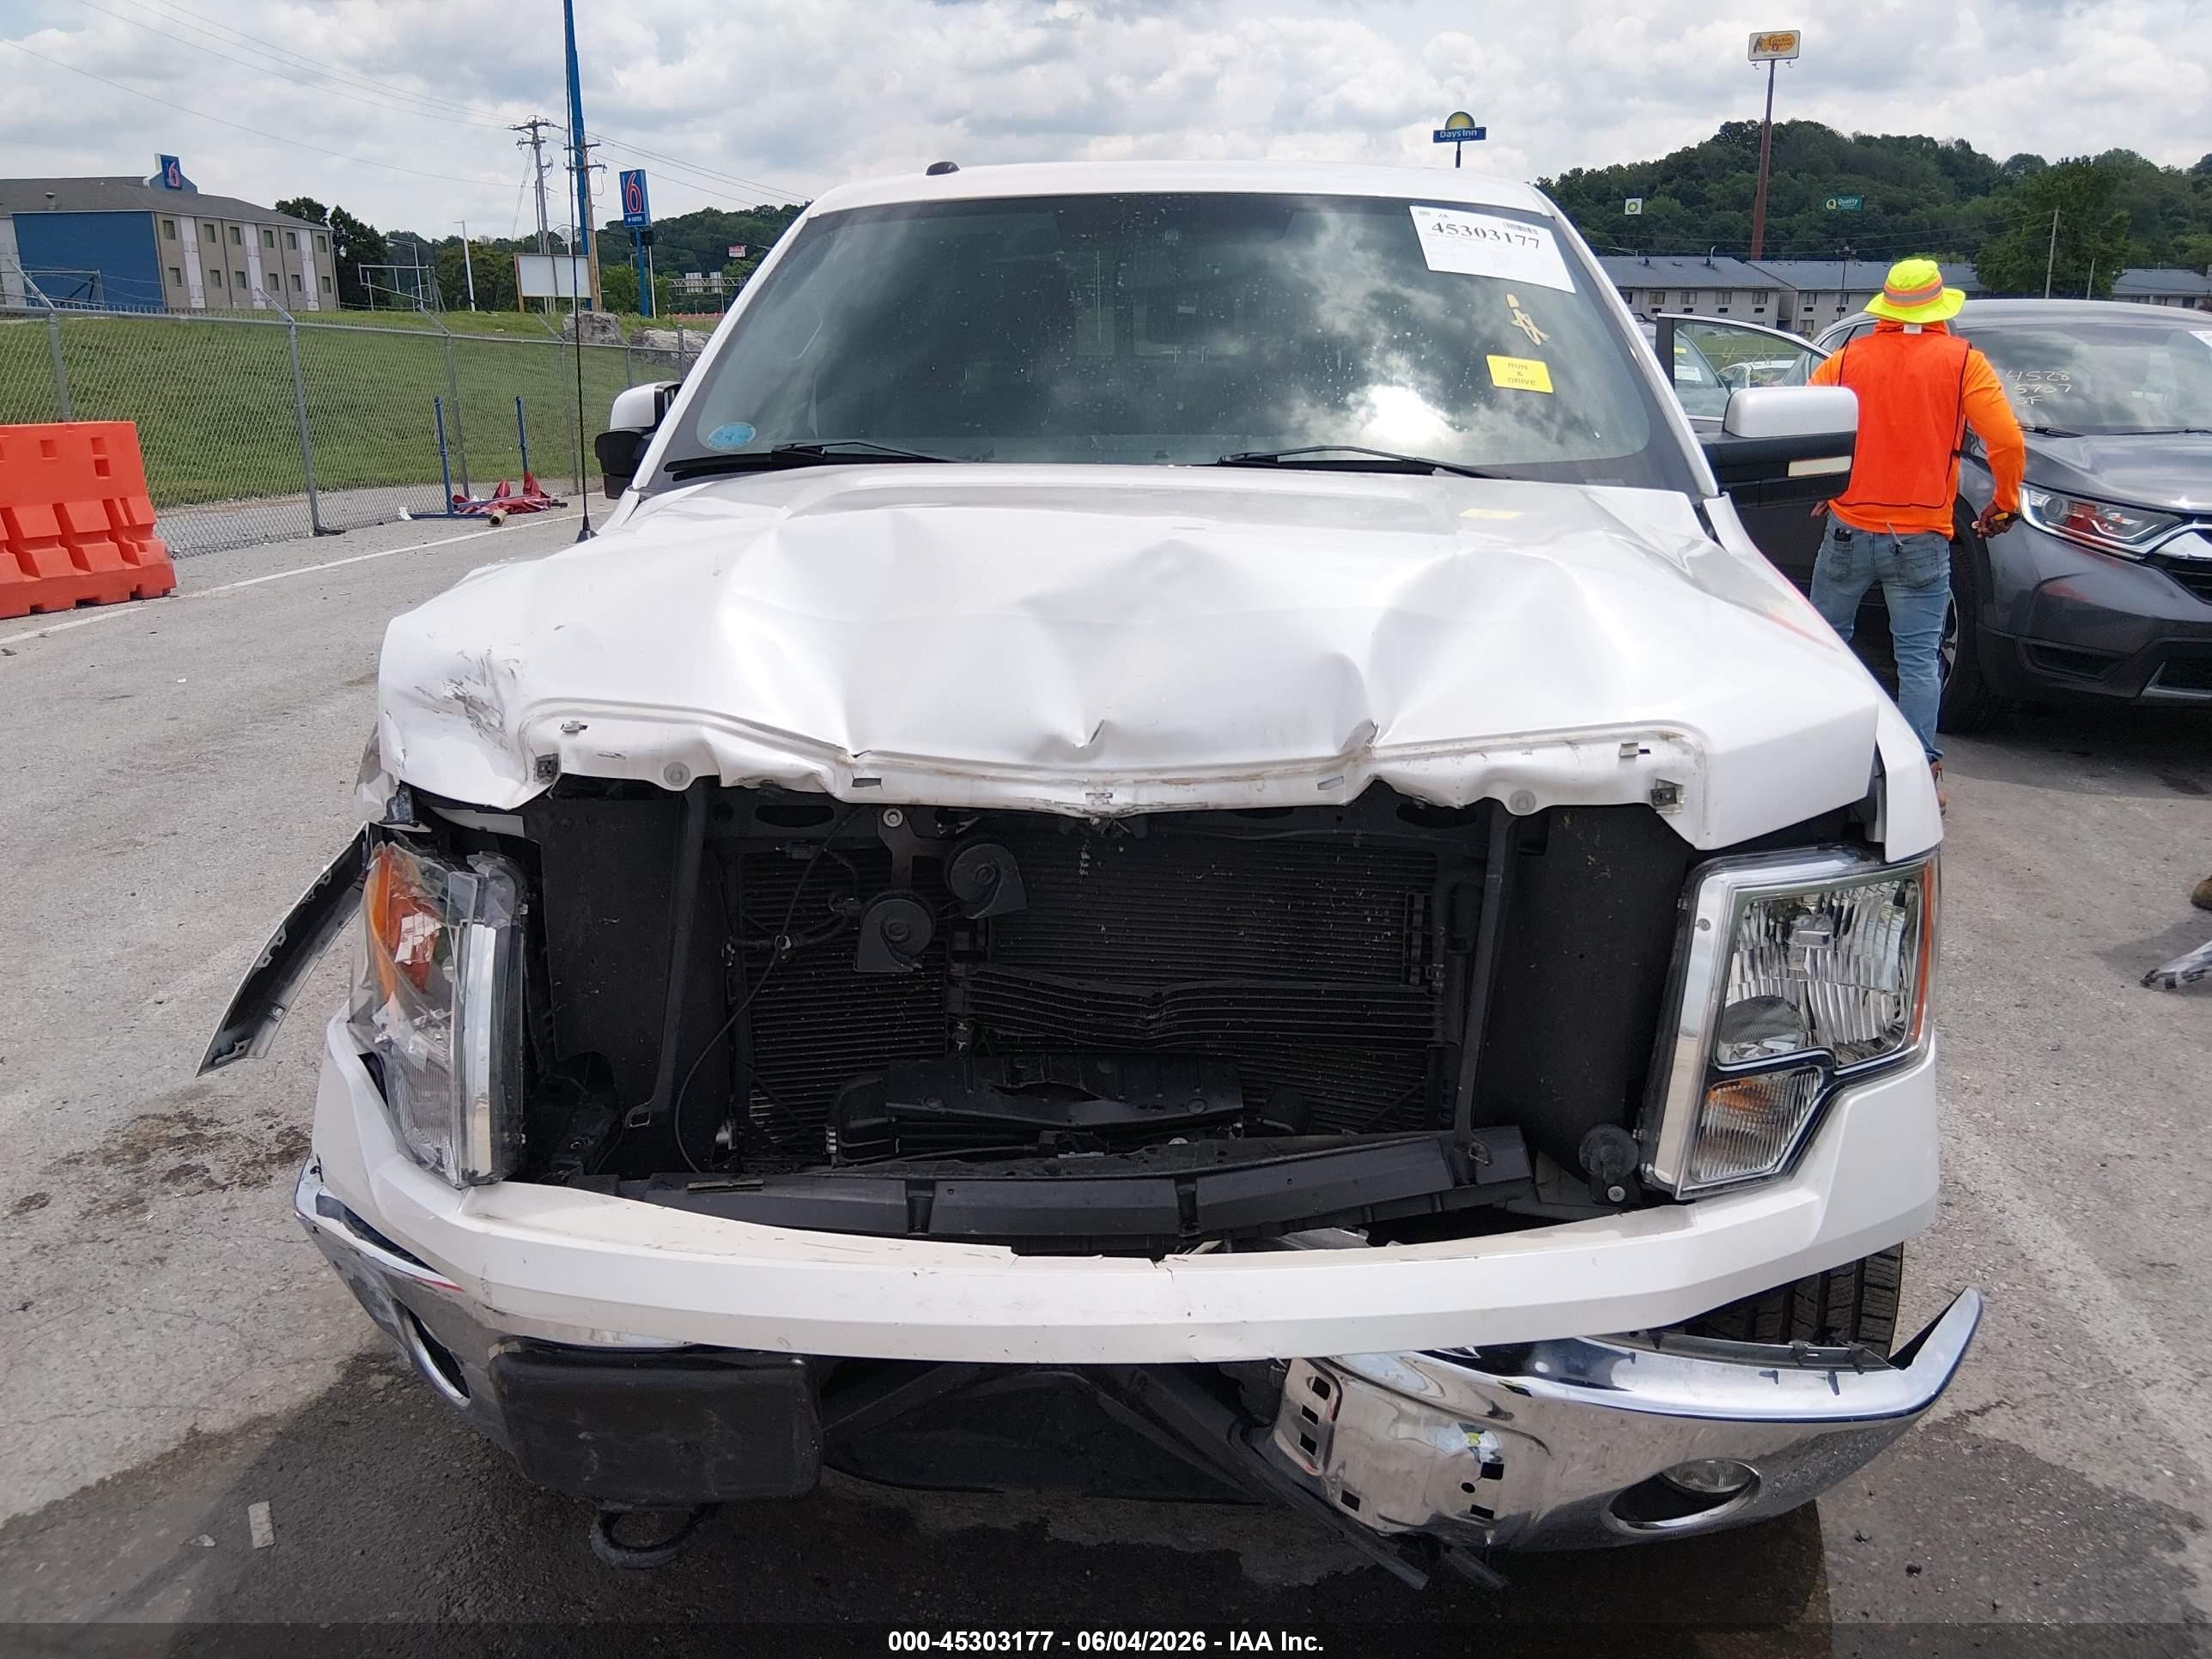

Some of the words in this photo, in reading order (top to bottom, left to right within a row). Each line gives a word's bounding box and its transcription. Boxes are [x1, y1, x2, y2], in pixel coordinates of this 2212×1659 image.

[1462, 129, 1478, 137] Inn
[168, 161, 179, 187] 6
[626, 172, 641, 214] 6
[1431, 222, 1540, 249] 45303177
[1507, 377, 1537, 386] DRIVE
[2005, 370, 2070, 381] 4528
